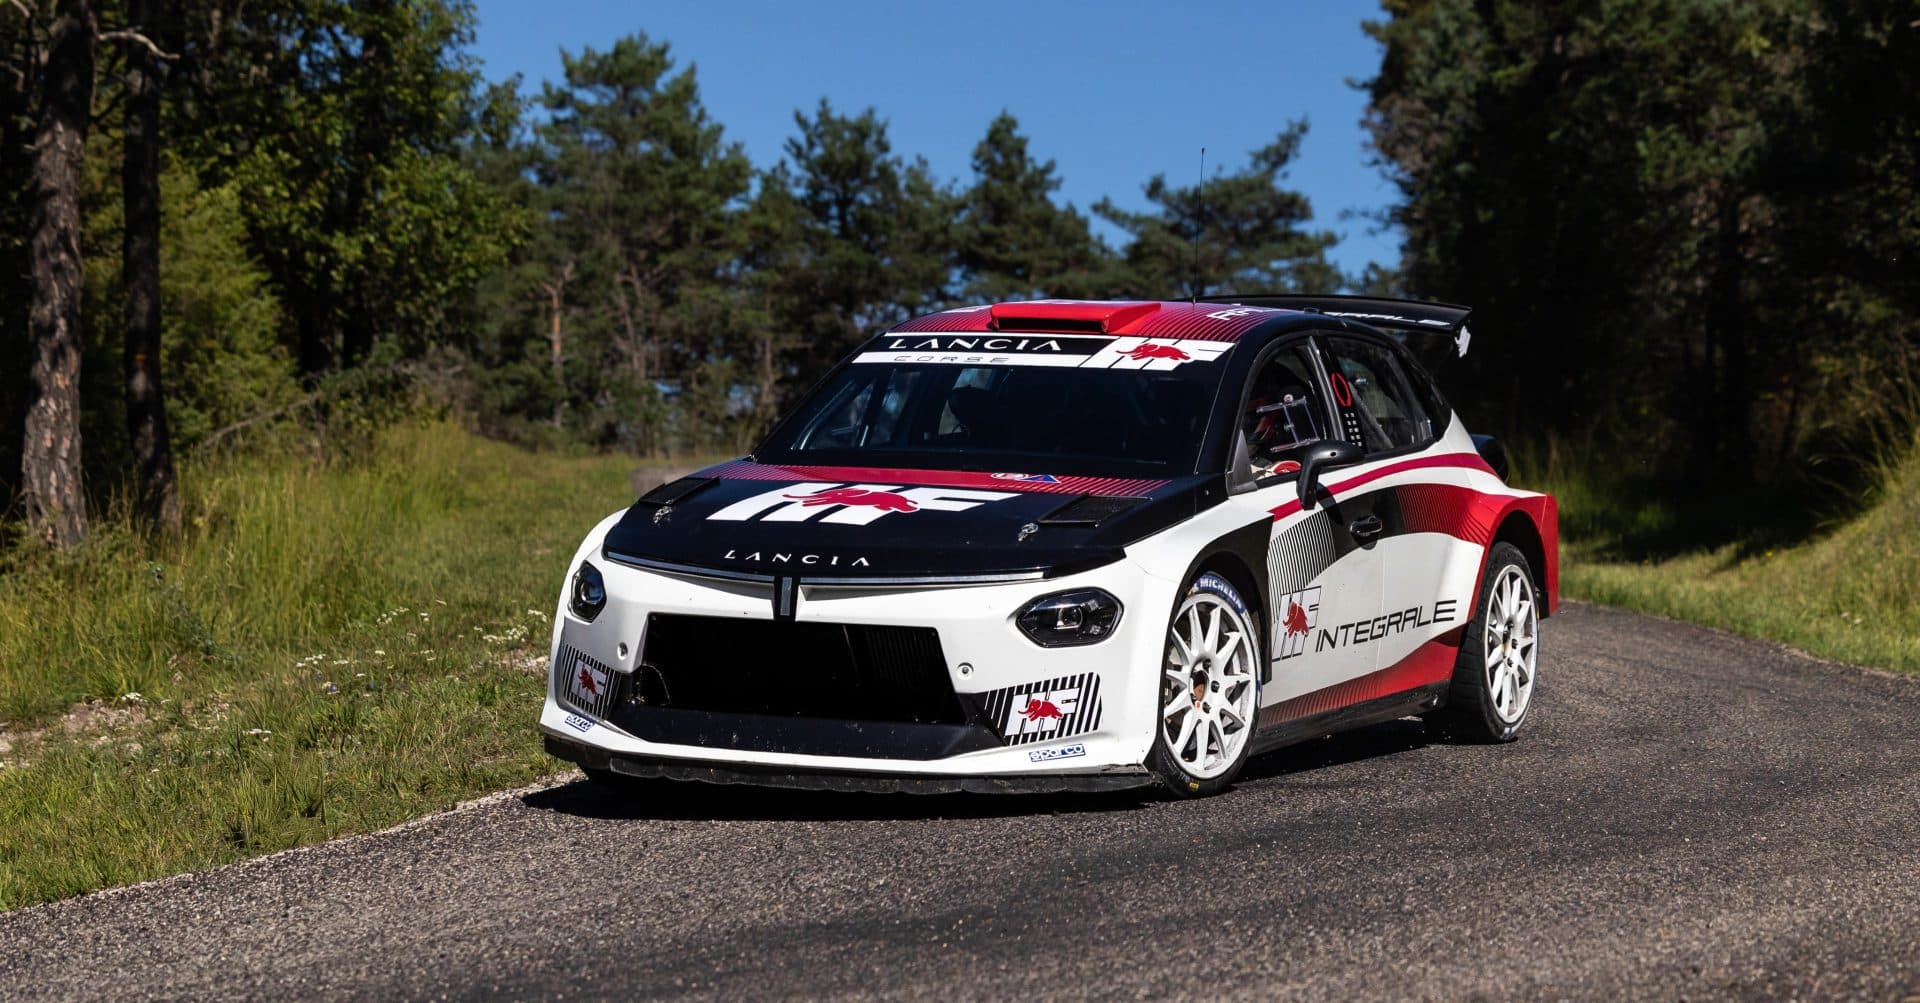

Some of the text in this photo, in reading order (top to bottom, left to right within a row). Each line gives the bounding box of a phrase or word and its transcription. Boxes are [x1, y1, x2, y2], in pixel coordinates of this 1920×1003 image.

[889, 338, 1062, 351] LANCIA
[893, 355, 1009, 364] CORSE
[705, 483, 1023, 526] HF
[724, 550, 870, 567] LANCIA
[1200, 578, 1242, 611] MICHELIN
[1271, 585, 1457, 662] HF INTEGRALE
[1004, 687, 1080, 736] HF
[1029, 745, 1085, 761] sparco
